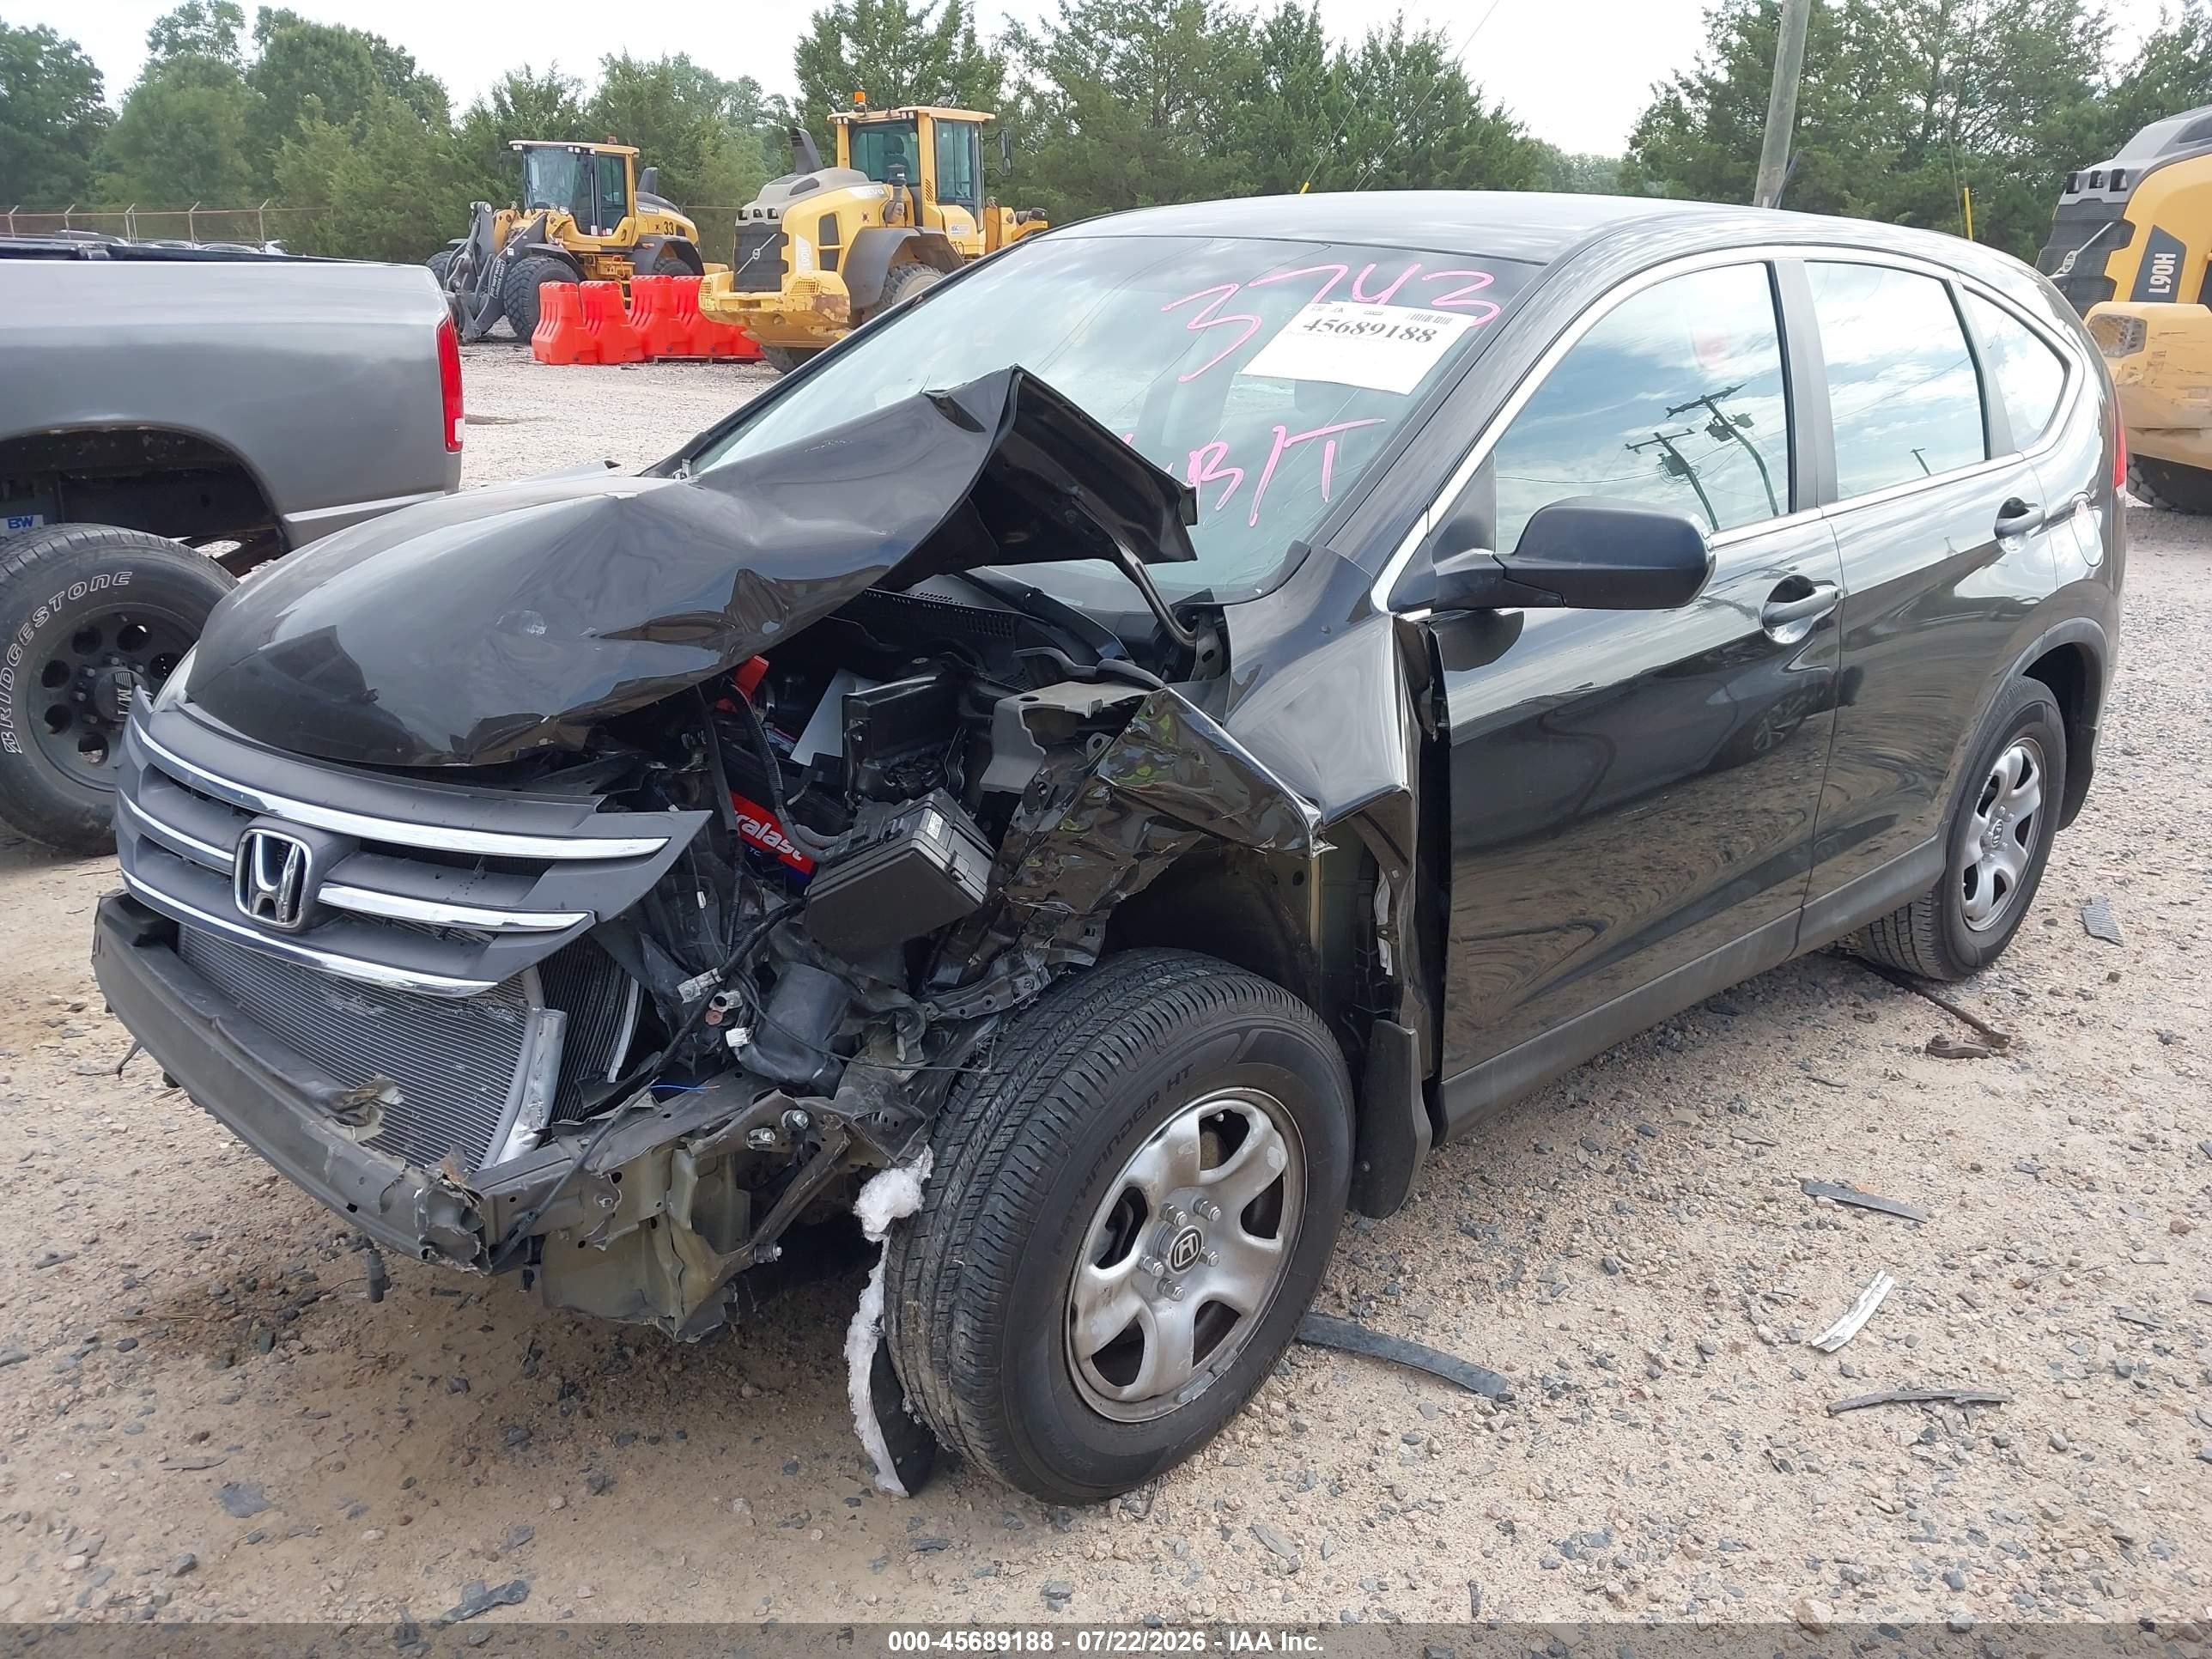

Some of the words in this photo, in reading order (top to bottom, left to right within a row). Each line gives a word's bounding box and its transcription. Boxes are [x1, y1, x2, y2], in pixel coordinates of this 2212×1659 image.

[663, 221, 674, 235] 33
[2148, 253, 2176, 294] L90H
[1303, 318, 1438, 343] 45689188
[1164, 419, 1386, 527] B/T
[7, 515, 33, 529] BW
[0, 571, 132, 755] BRIDGESTONE
[735, 810, 803, 861] ralast
[1165, 1062, 1195, 1094] HT
